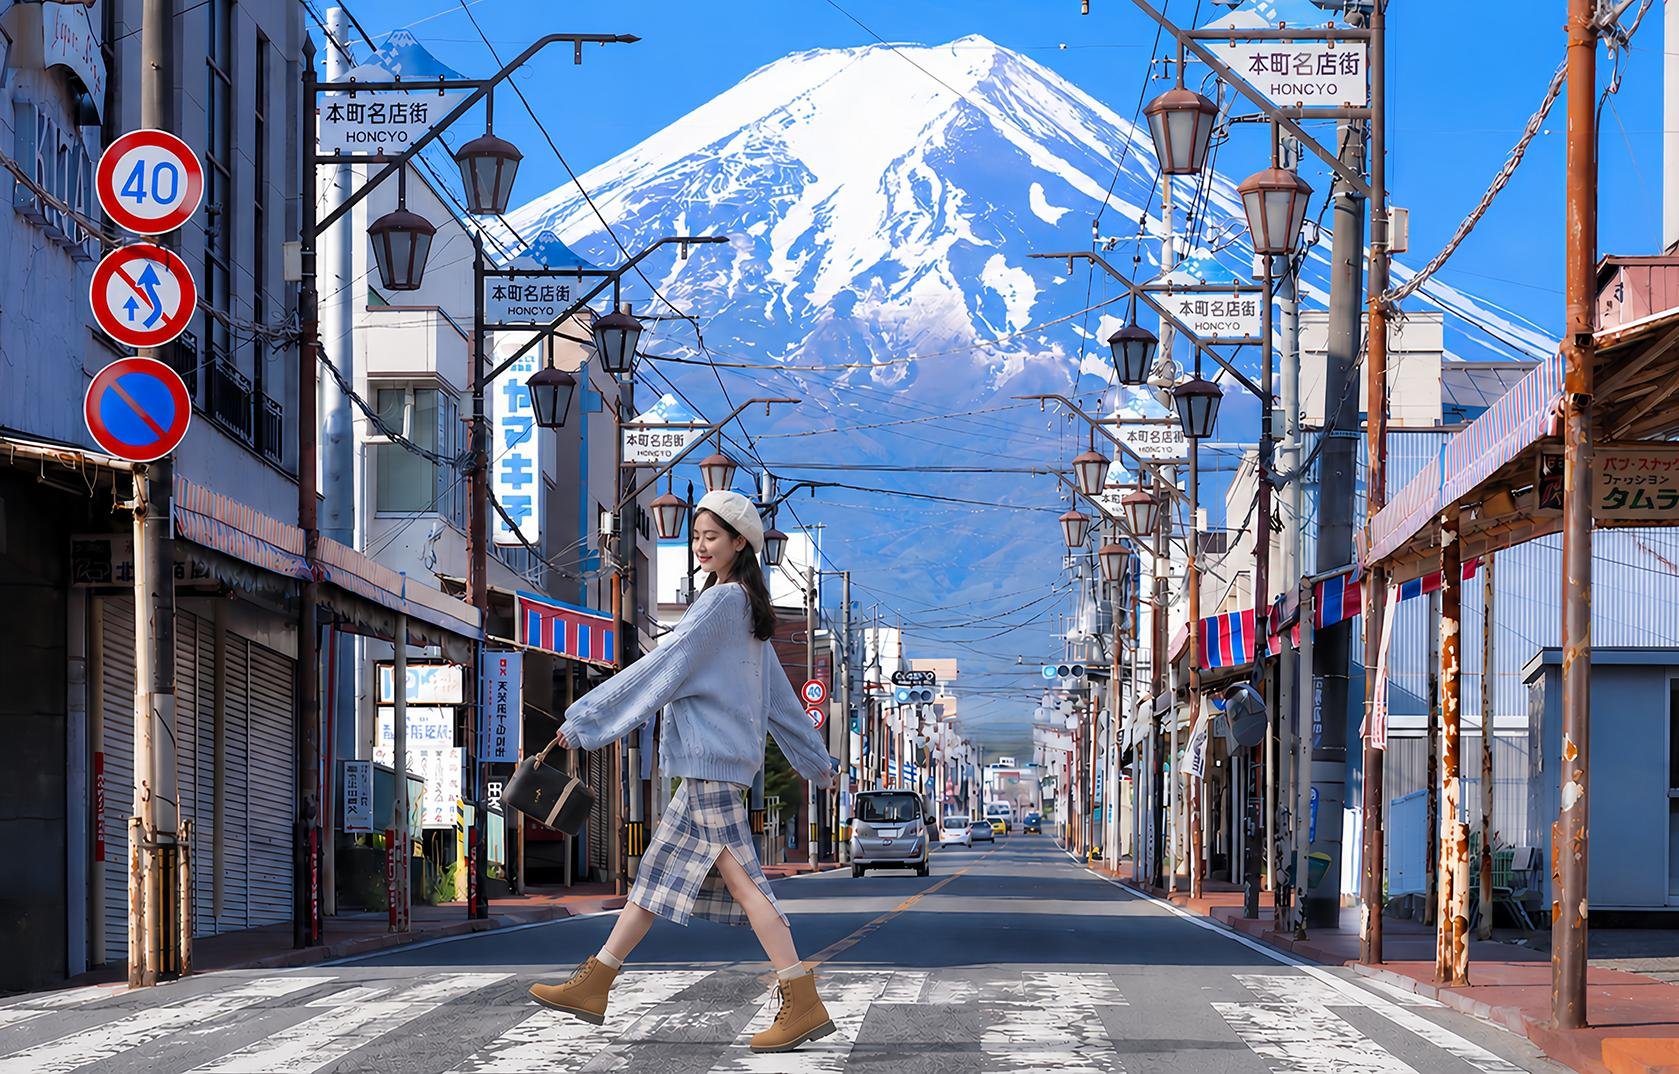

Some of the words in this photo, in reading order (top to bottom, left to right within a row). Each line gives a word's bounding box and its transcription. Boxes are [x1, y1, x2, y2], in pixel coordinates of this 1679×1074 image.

[1249, 52, 1360, 76] 本町名店街
[1270, 83, 1338, 96] HONCYO
[325, 102, 428, 124] 本町名店街
[346, 130, 408, 143] HONCYO
[120, 160, 180, 205] 40
[492, 285, 570, 303] 本町名店街
[507, 306, 554, 315] HONCYO
[1179, 300, 1255, 317] 本町名店街
[1194, 321, 1241, 331] HONCYO
[626, 434, 684, 447] 本町名店街
[1126, 430, 1184, 444] 本町名店街
[1601, 486, 1679, 510] タムラ
